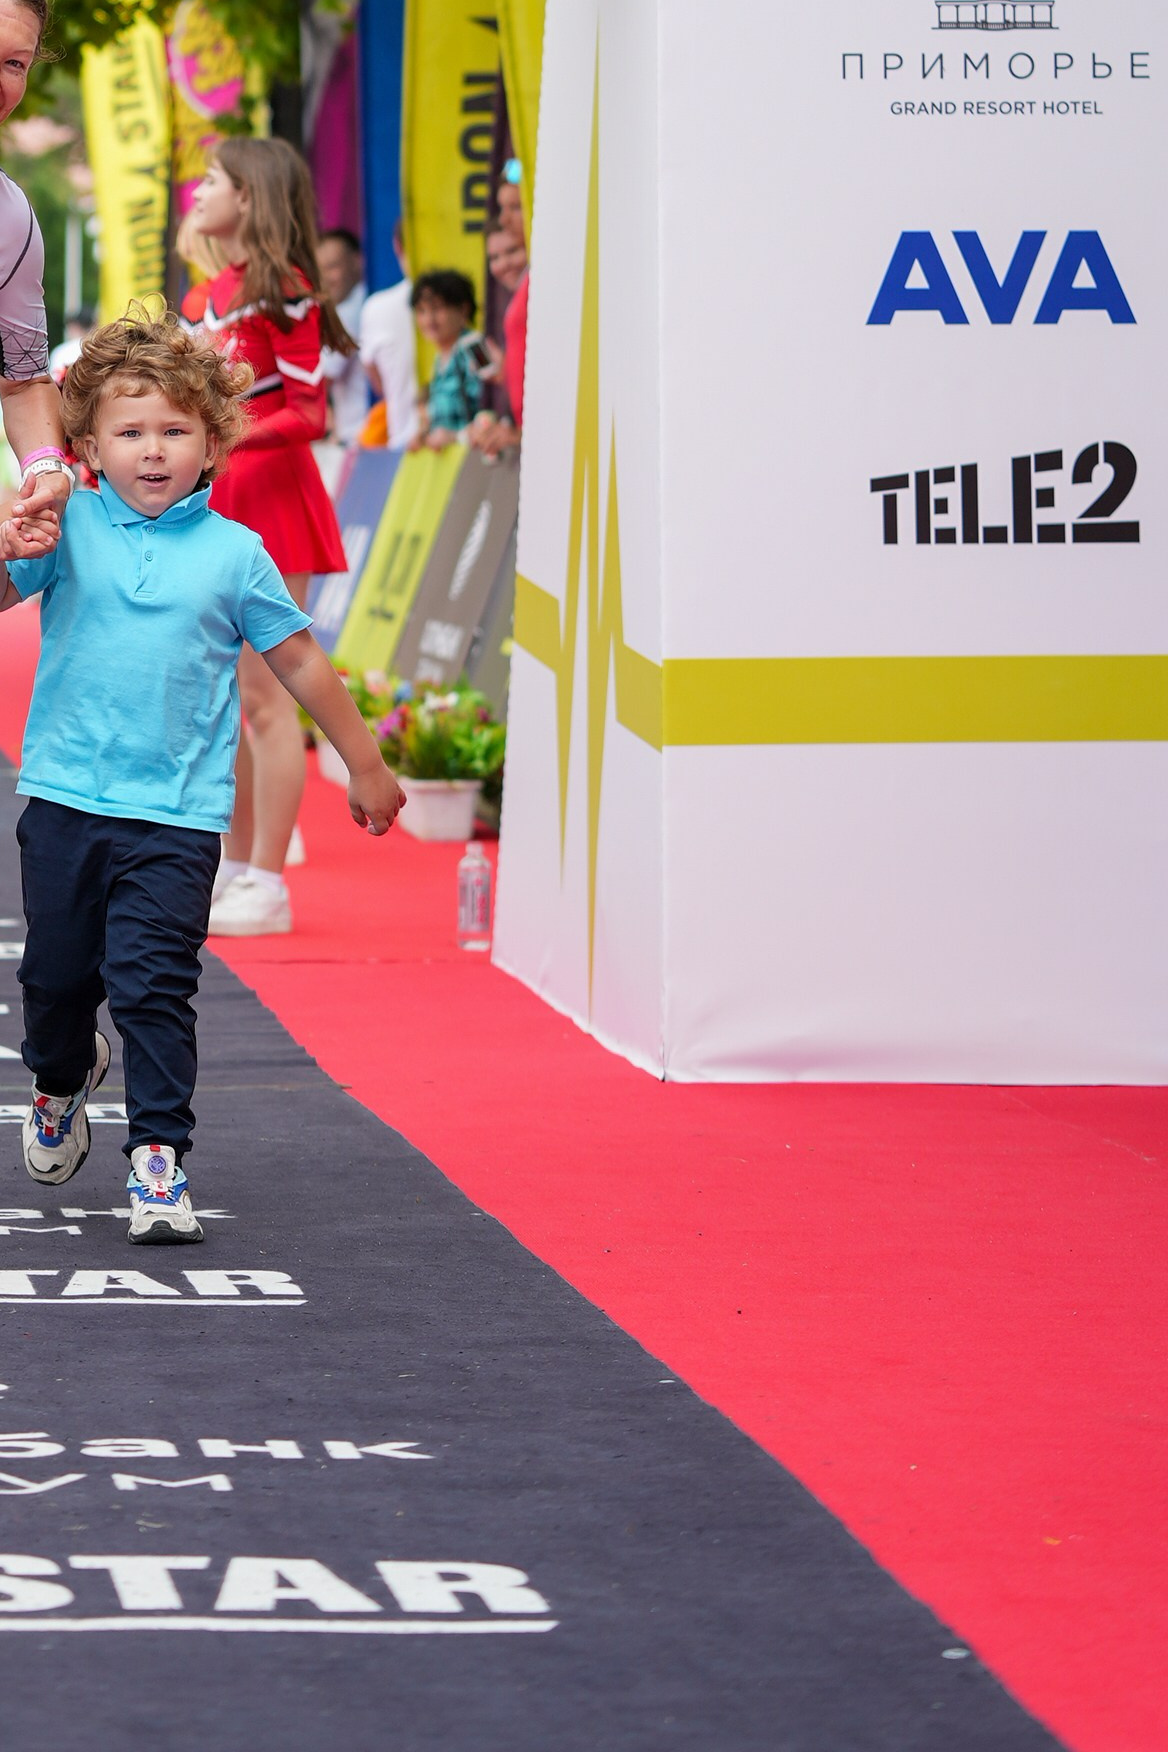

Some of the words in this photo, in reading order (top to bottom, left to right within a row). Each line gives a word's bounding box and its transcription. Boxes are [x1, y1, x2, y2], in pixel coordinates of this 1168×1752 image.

[841, 52, 1151, 80] ПРИМОРЬЕ
[889, 100, 957, 116] GRAND
[963, 100, 1036, 116] RESORT
[1043, 100, 1103, 116] HOTEL
[865, 229, 1138, 325] AVA
[869, 440, 1140, 545] TELE2
